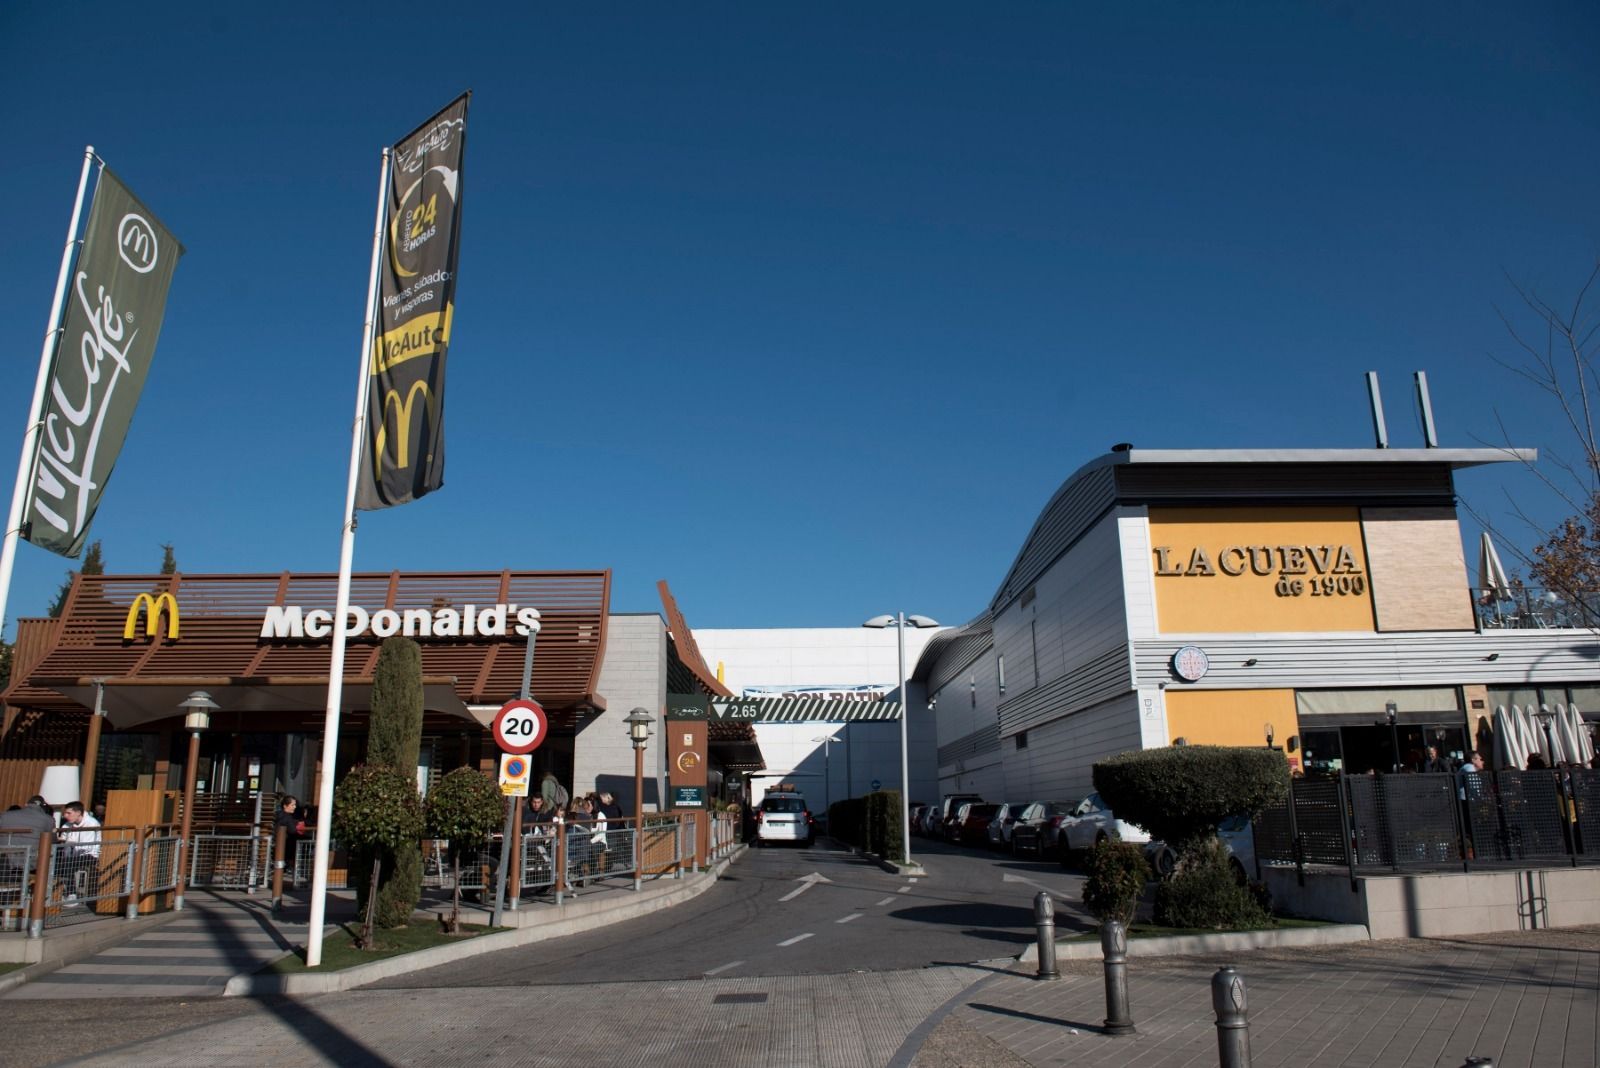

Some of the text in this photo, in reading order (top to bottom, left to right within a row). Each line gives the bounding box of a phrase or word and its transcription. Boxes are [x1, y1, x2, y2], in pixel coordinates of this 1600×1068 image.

[411, 193, 437, 239] 24
[410, 224, 437, 252] HORAS
[1153, 545, 1362, 576] LA CUEVA
[1275, 575, 1366, 597] de 1900
[260, 604, 542, 638] McDonald's
[731, 705, 757, 718] 2.65
[505, 718, 533, 736] 20
